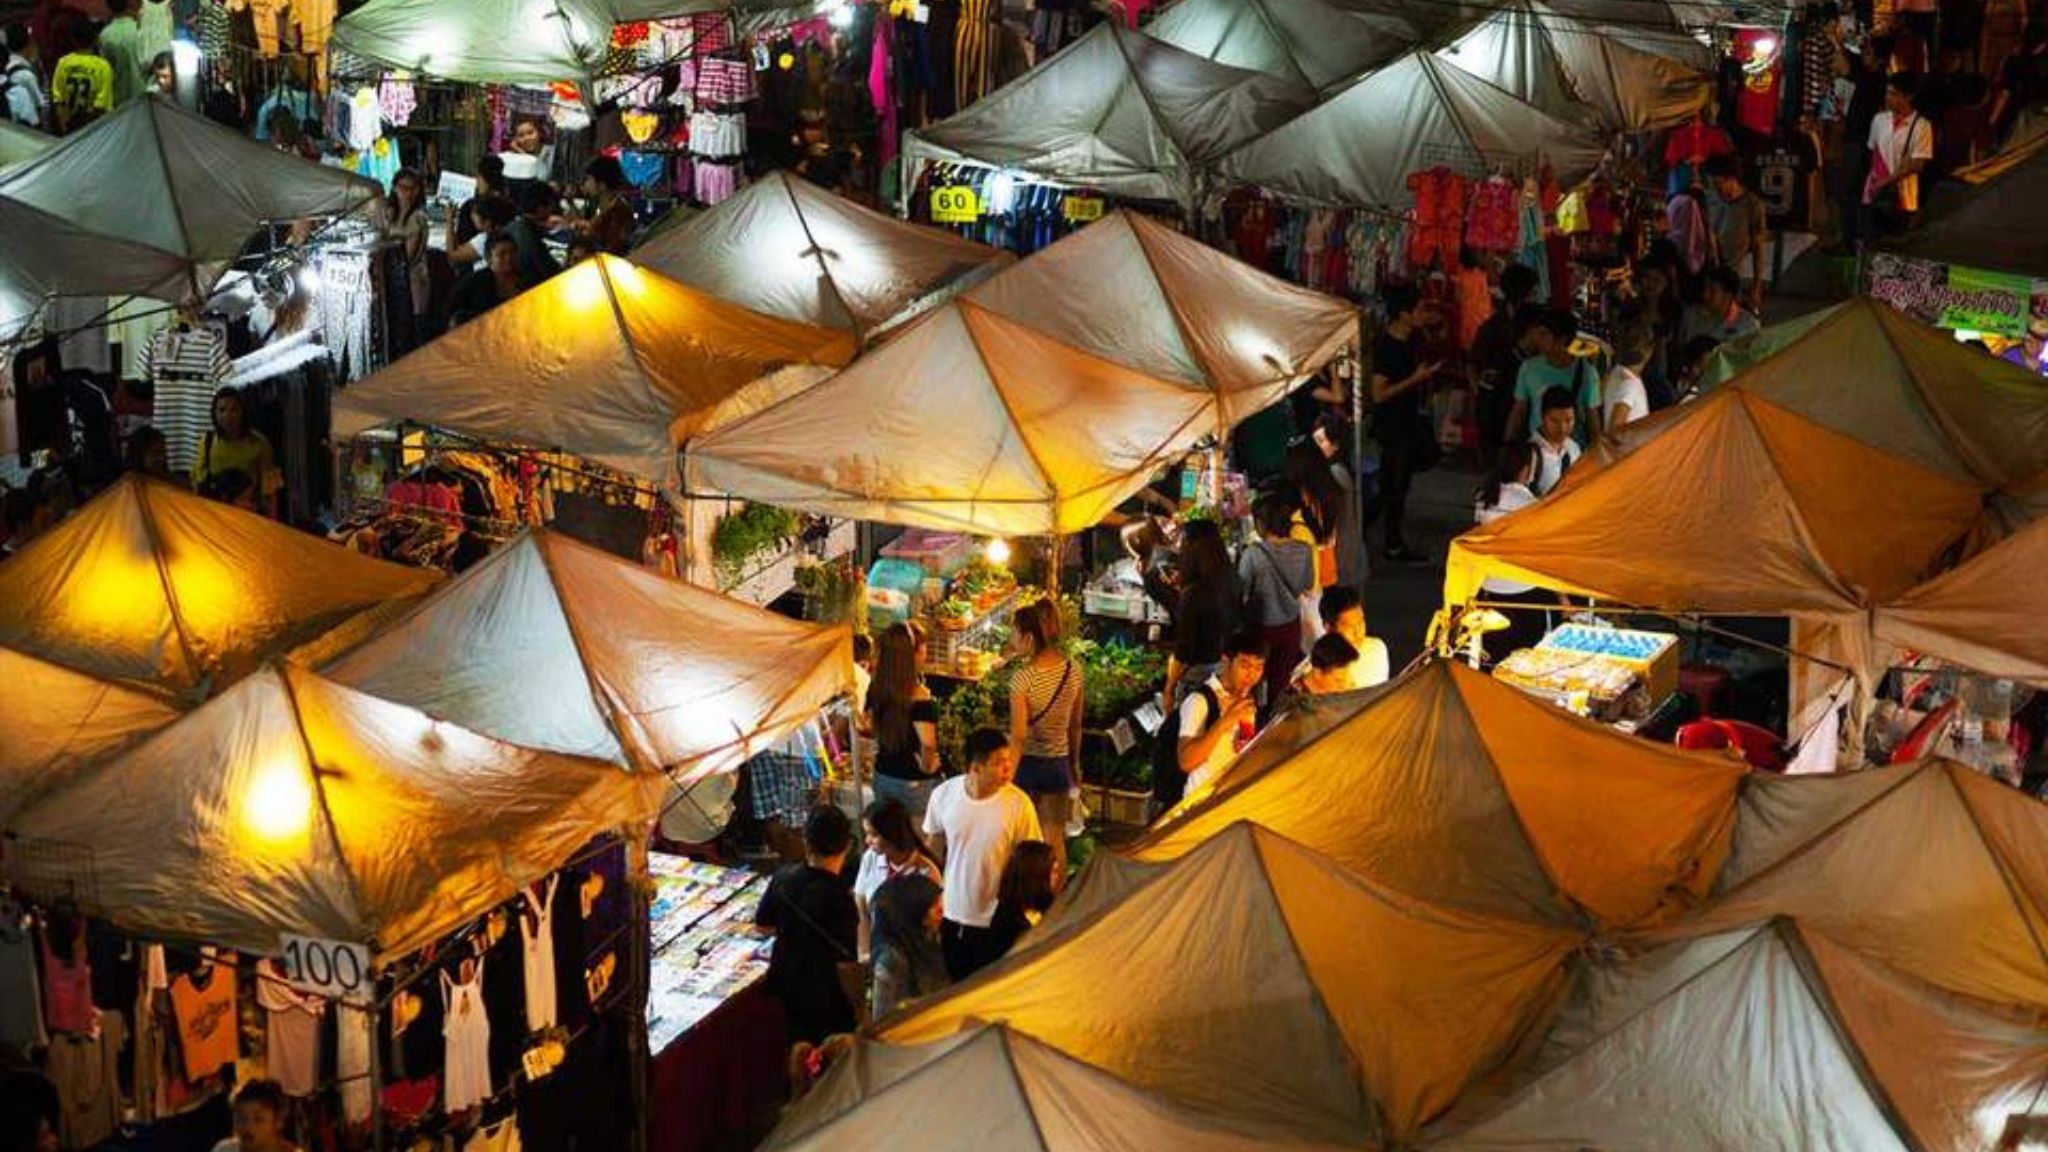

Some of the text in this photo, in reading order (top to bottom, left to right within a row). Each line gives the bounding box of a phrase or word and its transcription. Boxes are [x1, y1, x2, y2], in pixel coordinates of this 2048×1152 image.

[938, 193, 966, 210] 60
[330, 267, 358, 285] 150
[286, 939, 360, 990] 100
